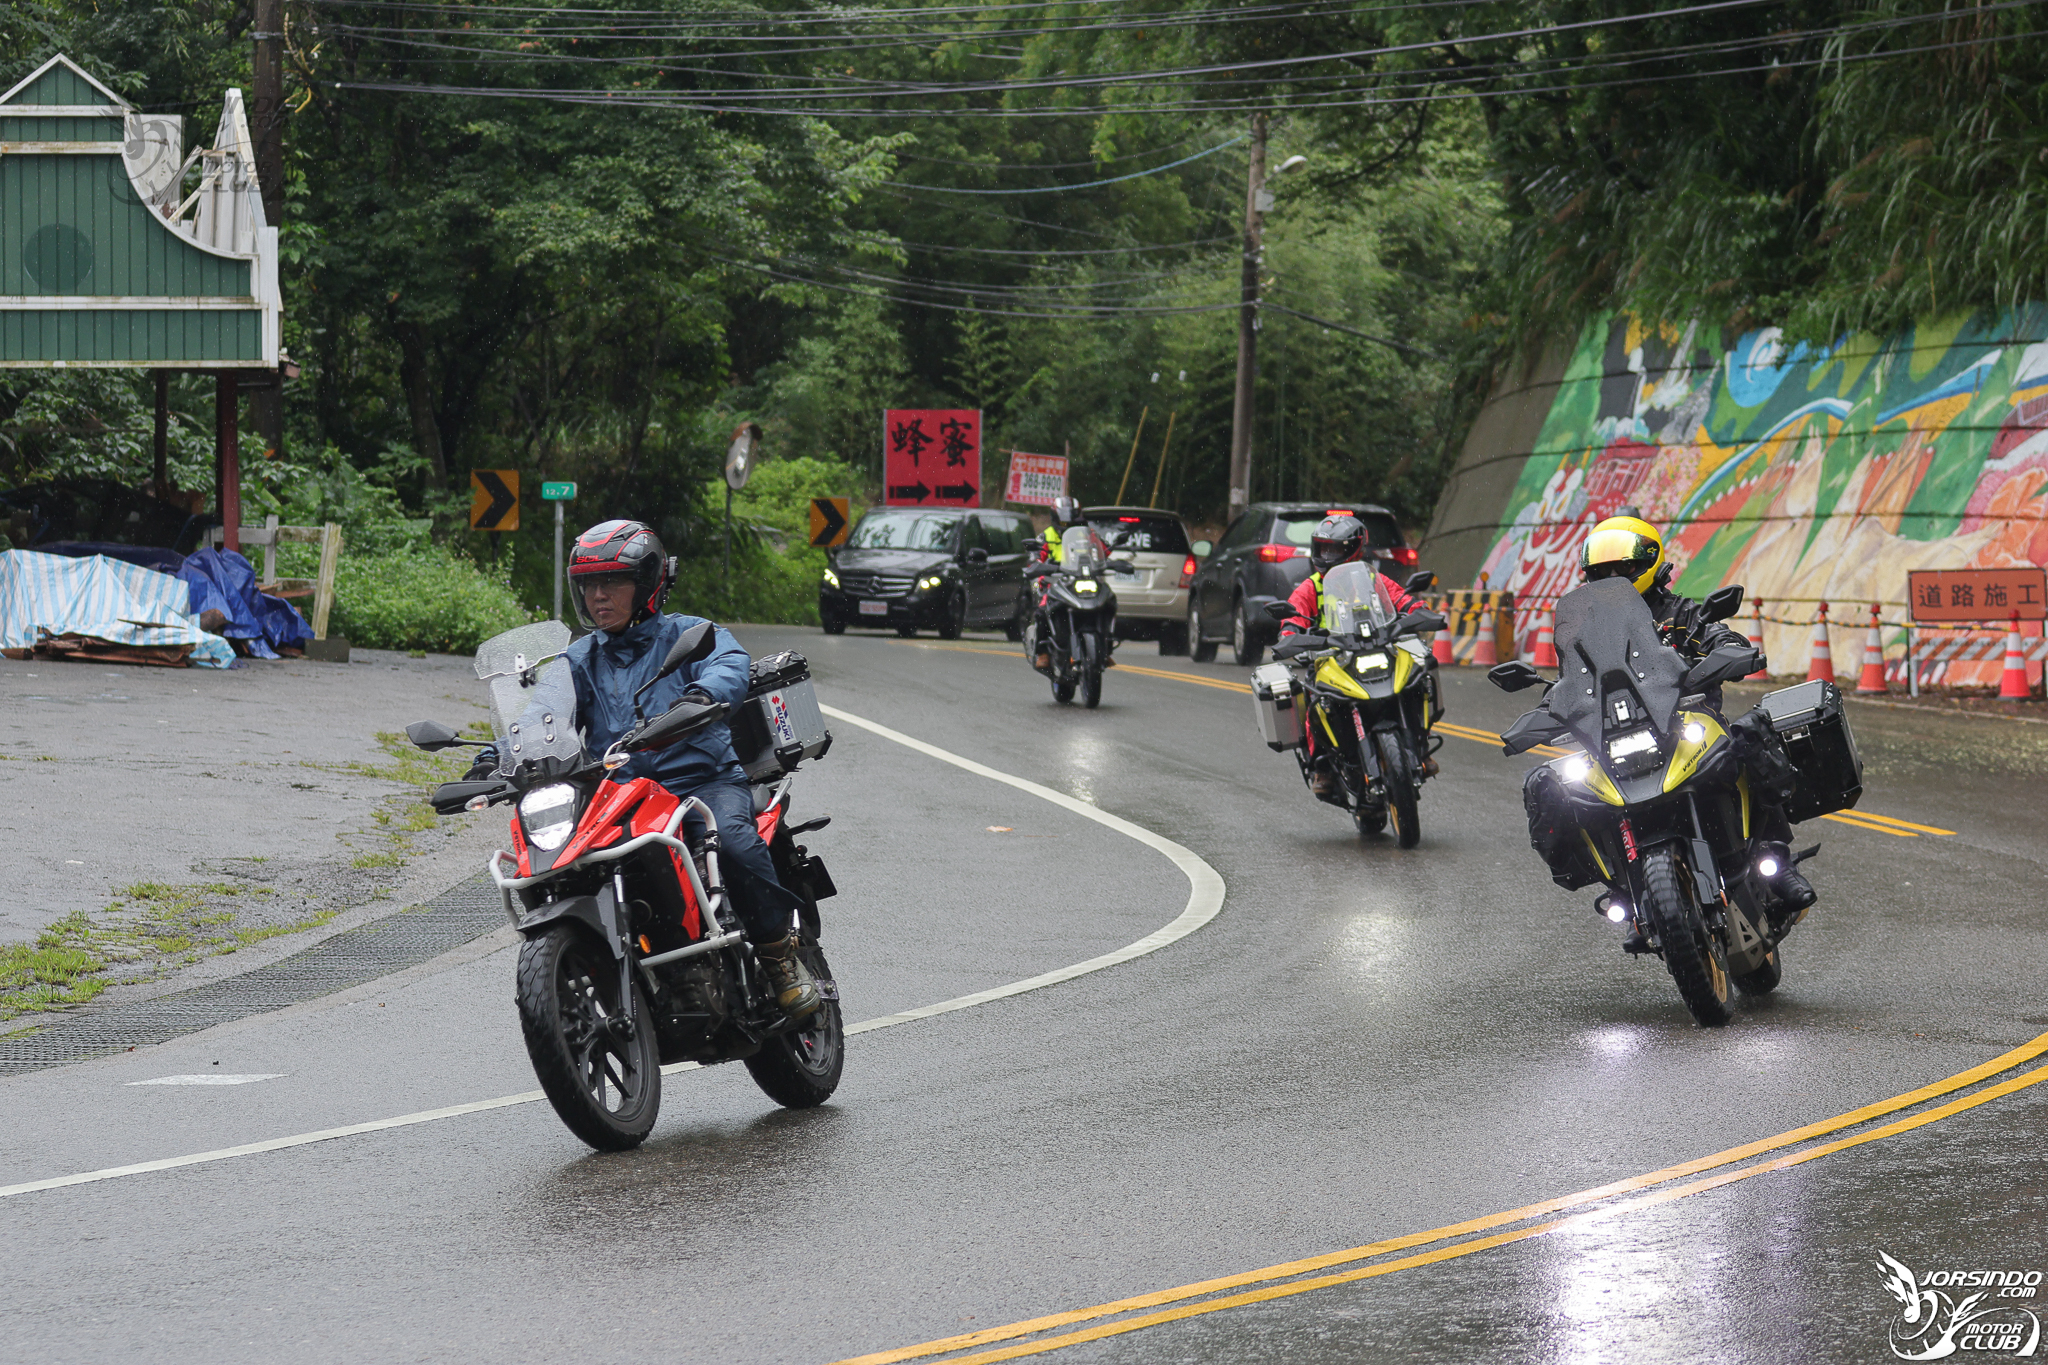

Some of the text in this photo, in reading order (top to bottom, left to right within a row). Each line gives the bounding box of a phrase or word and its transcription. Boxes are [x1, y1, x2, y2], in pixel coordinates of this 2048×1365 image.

[891, 417, 974, 467] 蜂蜜
[546, 486, 570, 495] 12.7
[1918, 583, 2040, 608] 道路施工
[775, 706, 791, 741] SUZUKI
